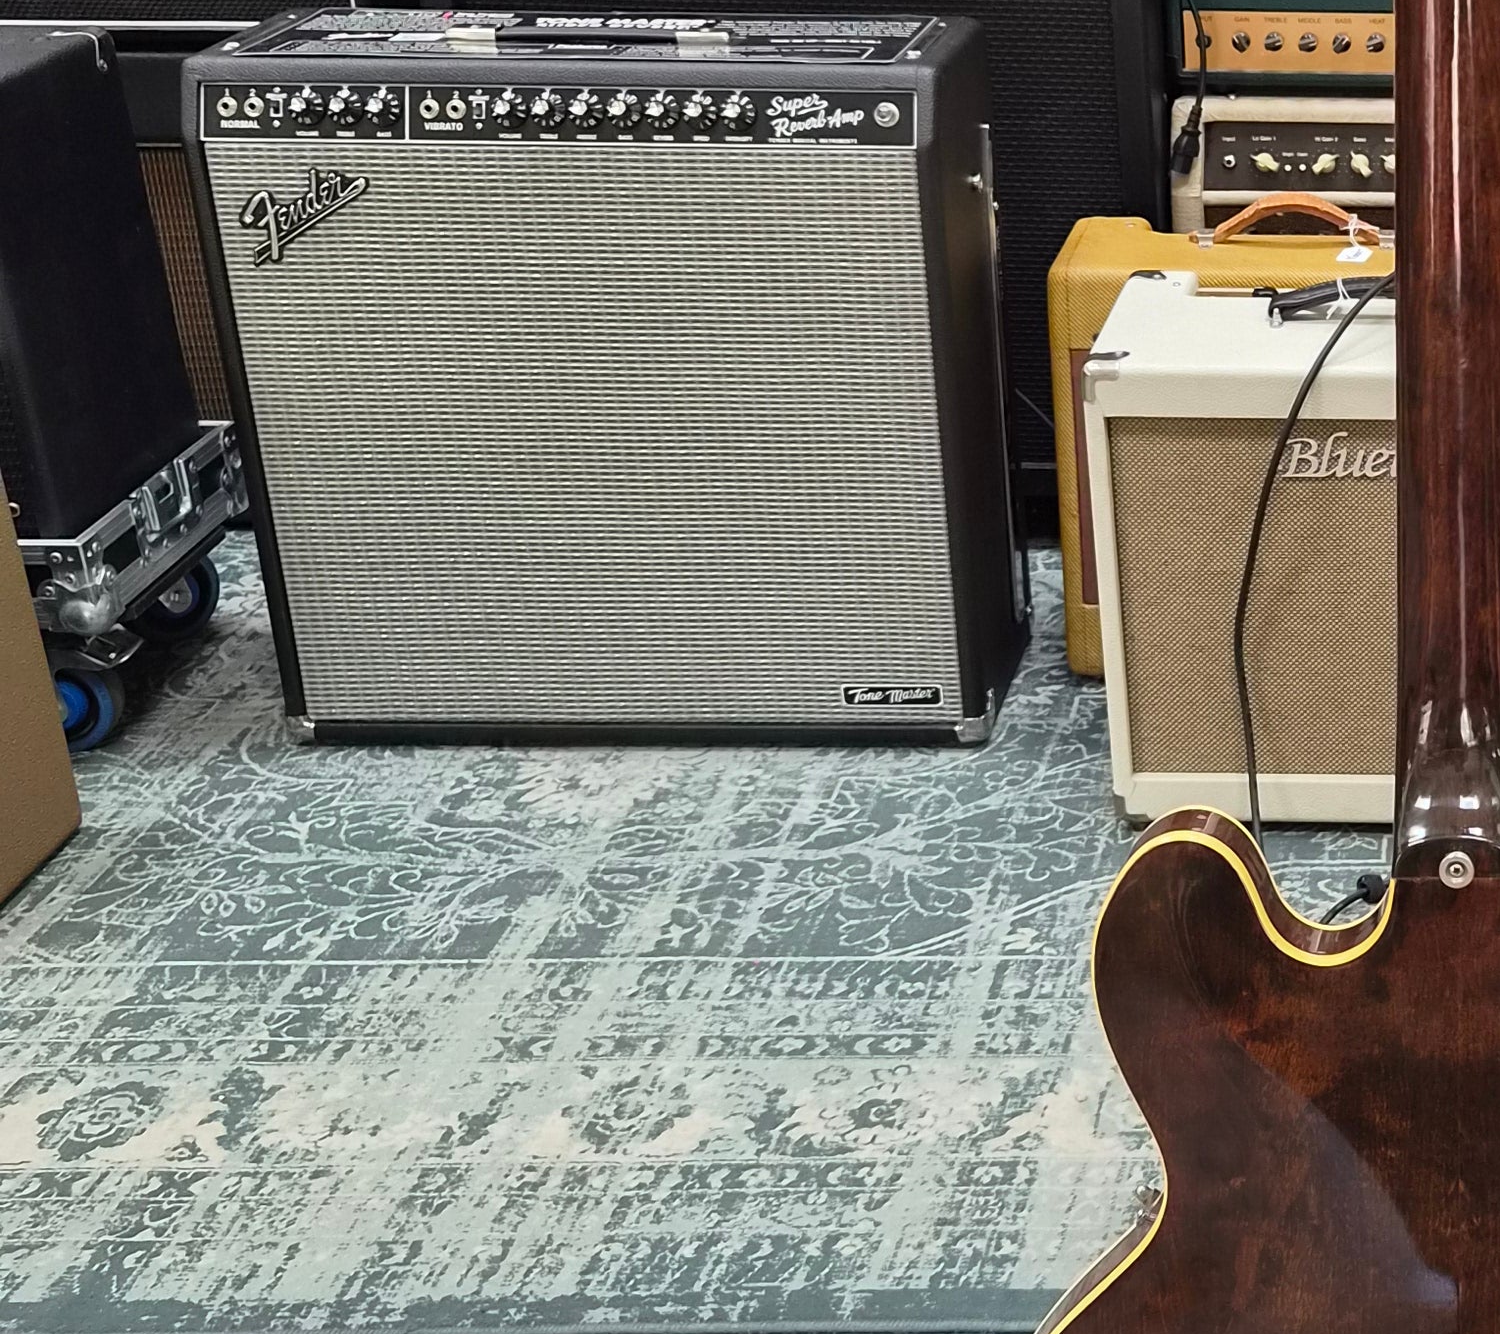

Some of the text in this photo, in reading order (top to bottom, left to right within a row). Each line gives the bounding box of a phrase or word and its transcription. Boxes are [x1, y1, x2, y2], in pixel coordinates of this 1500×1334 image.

[1263, 16, 1288, 24] TREBLE
[765, 93, 829, 117] Super
[219, 119, 261, 129] NORMAL
[424, 121, 464, 132] VIBRATO
[242, 168, 367, 264] Fender
[847, 687, 936, 704] Tone Master
